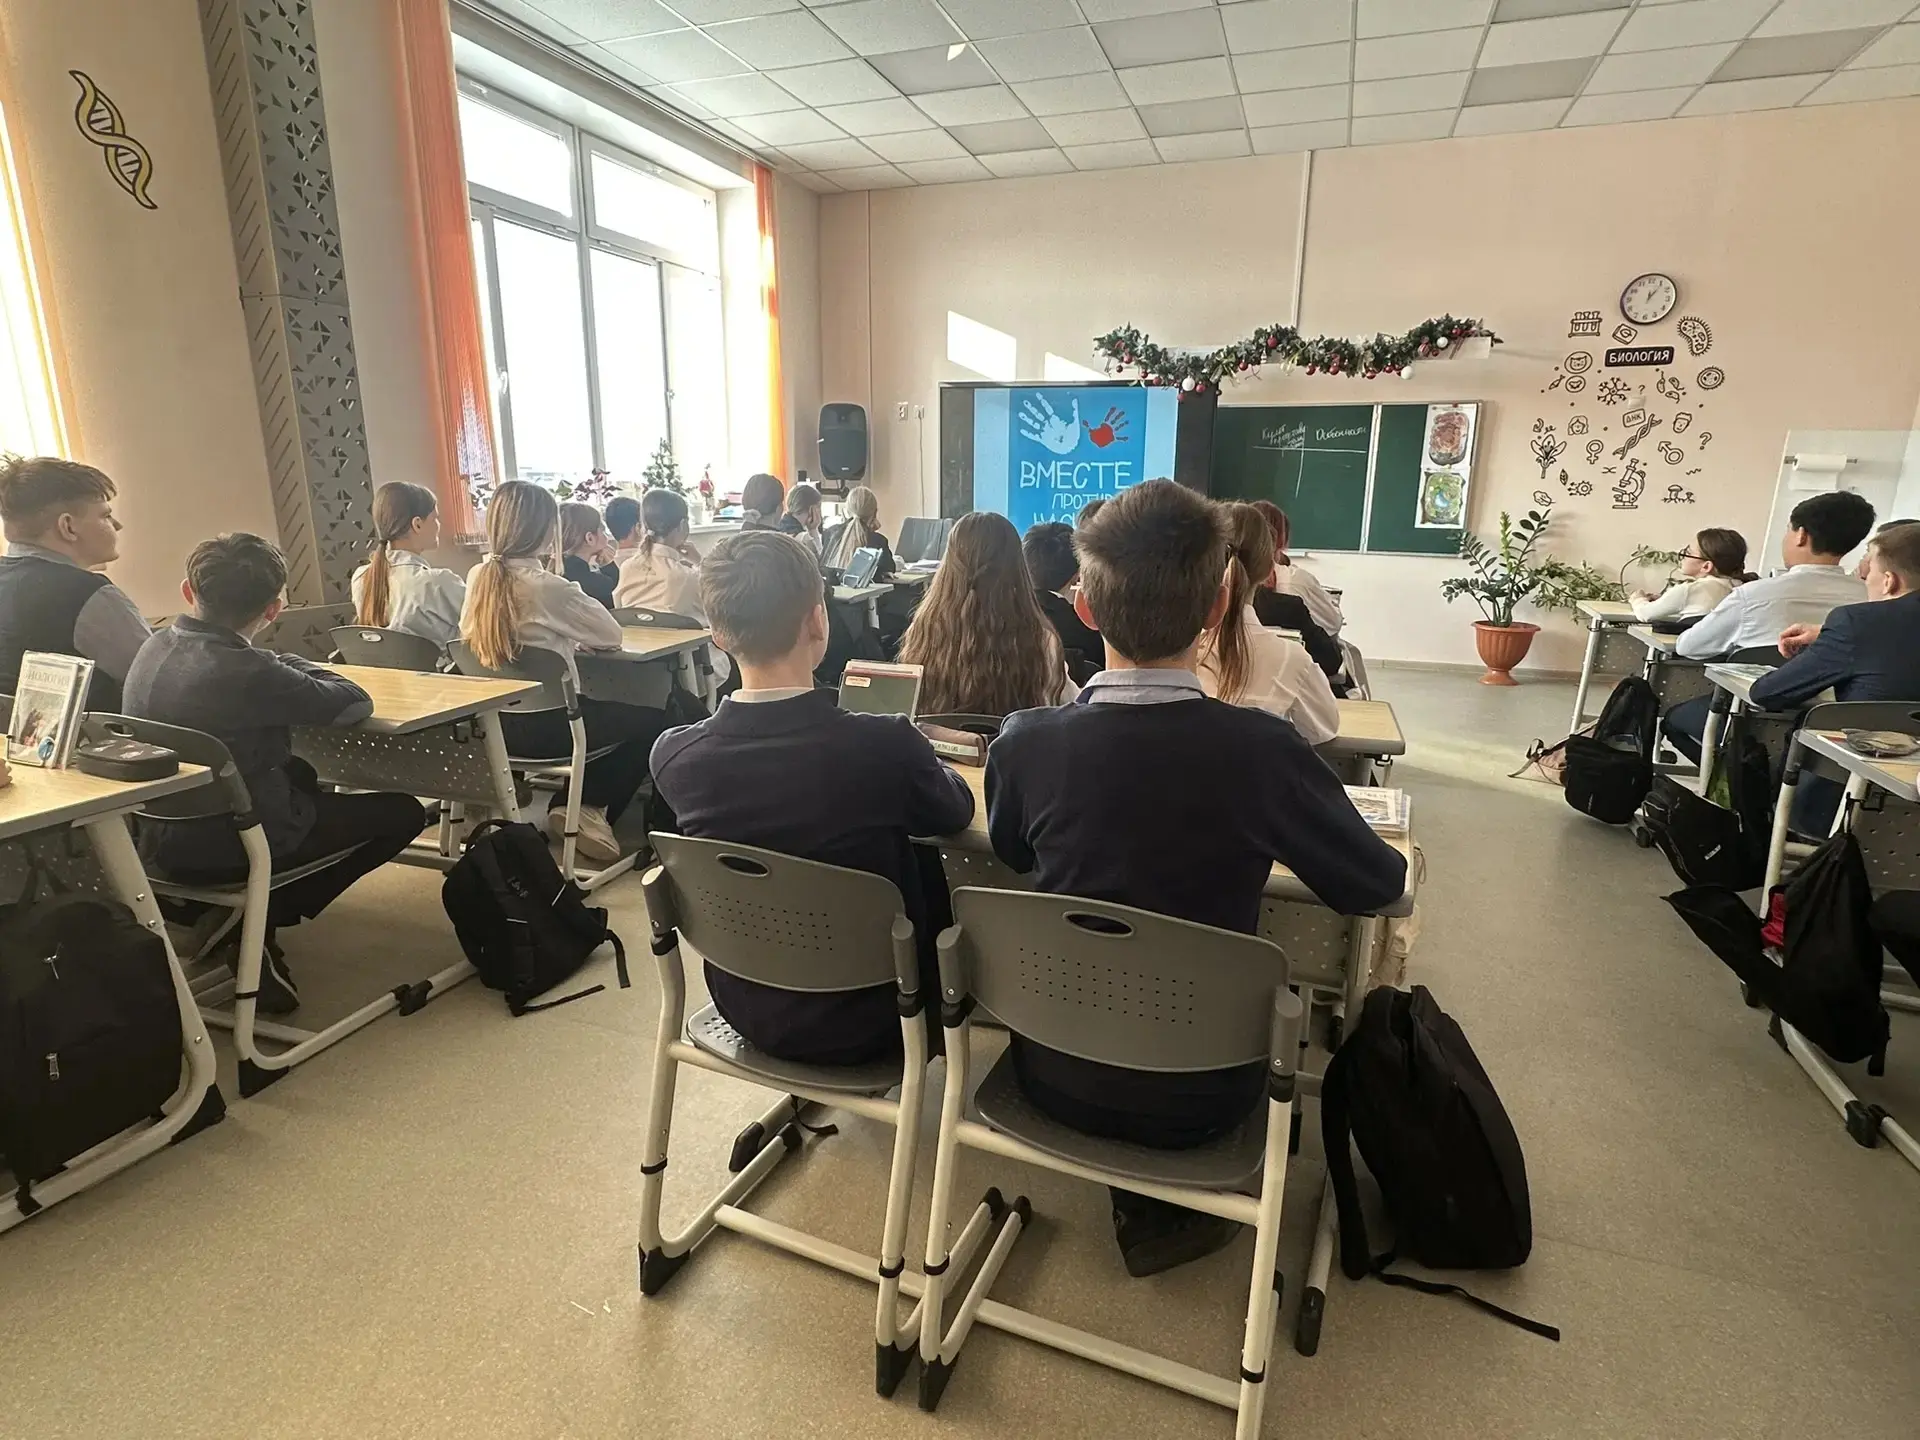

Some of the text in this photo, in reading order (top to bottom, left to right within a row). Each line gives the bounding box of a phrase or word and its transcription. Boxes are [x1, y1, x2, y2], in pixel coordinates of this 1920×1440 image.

[1609, 350, 1670, 363] БИОЛОГИЯ
[1626, 413, 1642, 423] ДНК
[1020, 460, 1132, 489] ВМЕСТЕ
[24, 671, 69, 686] ИОЛОГИЯ
